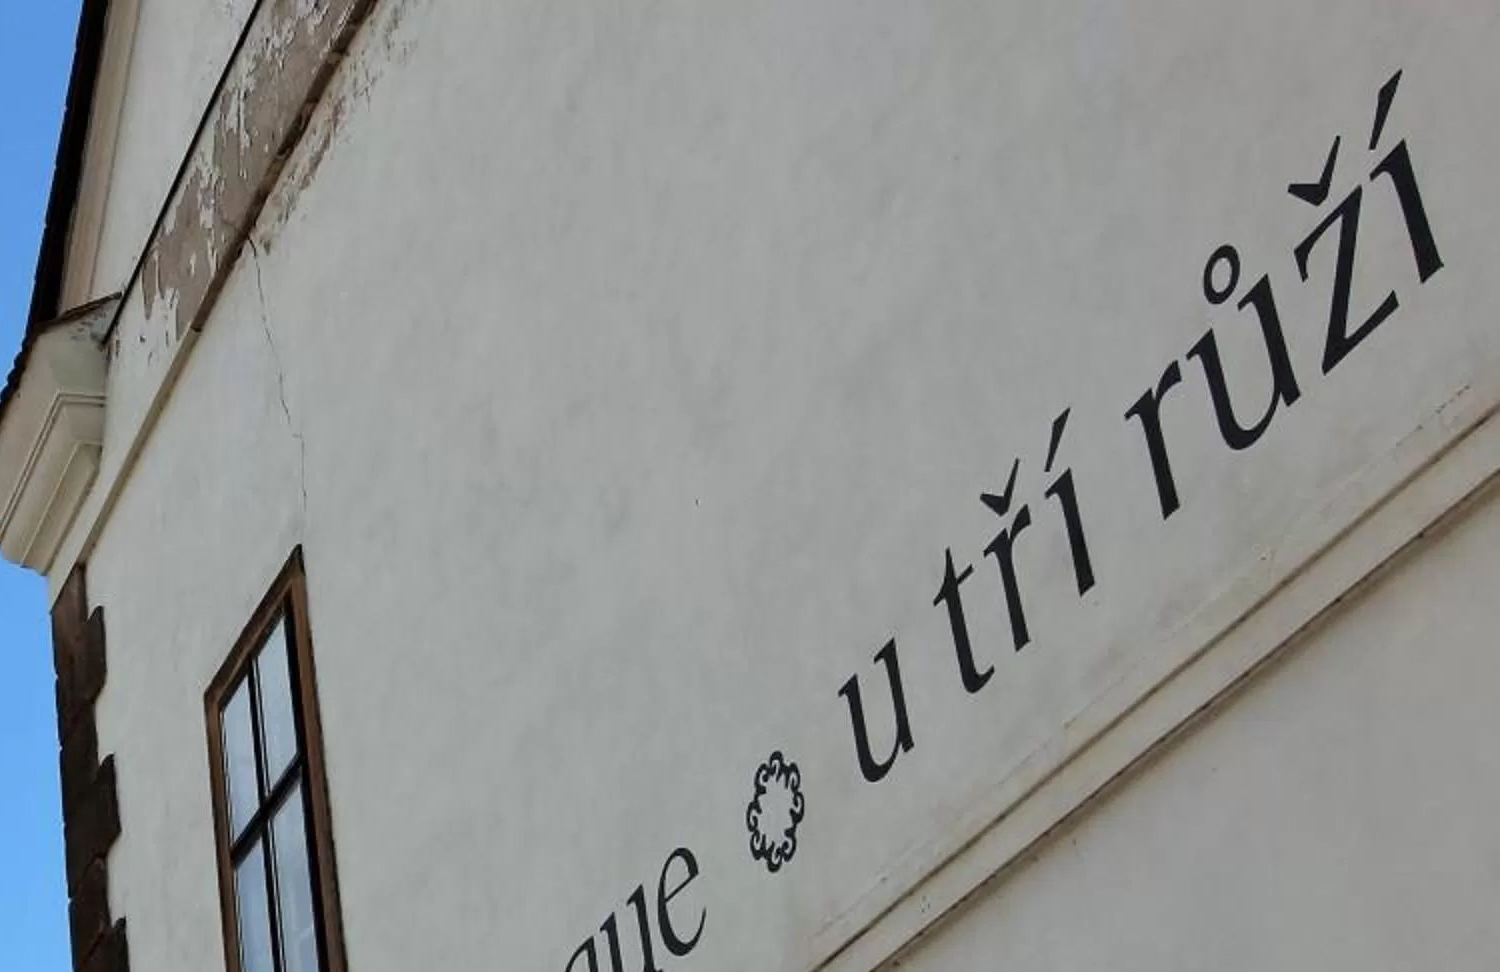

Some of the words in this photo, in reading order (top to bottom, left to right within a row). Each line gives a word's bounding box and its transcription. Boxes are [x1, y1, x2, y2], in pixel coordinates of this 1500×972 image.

[837, 637, 915, 784] u
[933, 407, 1096, 695] tří
[1124, 69, 1445, 520] růží
